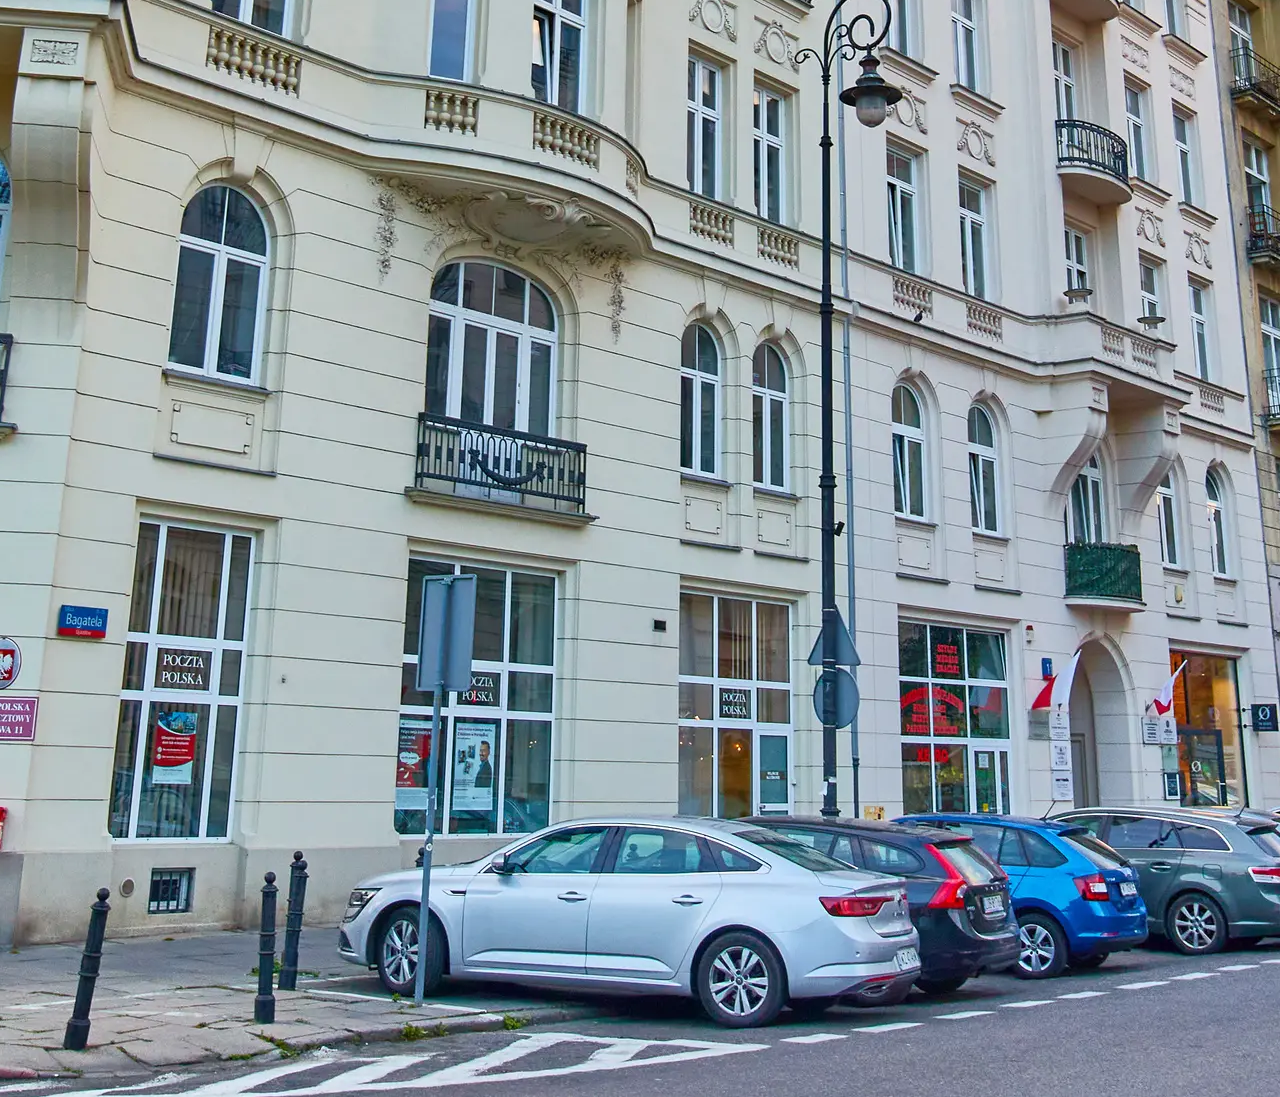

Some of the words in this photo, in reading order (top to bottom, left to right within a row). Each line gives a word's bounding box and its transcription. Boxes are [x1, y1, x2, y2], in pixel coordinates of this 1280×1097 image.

[66, 613, 102, 628] Bagatela
[163, 653, 204, 668] POCZTA
[162, 671, 203, 685] POLSKA
[462, 690, 494, 702] POLSKA
[722, 692, 746, 702] POCZTA
[722, 705, 747, 715] POLSKA
[14, 726, 23, 734] 11
